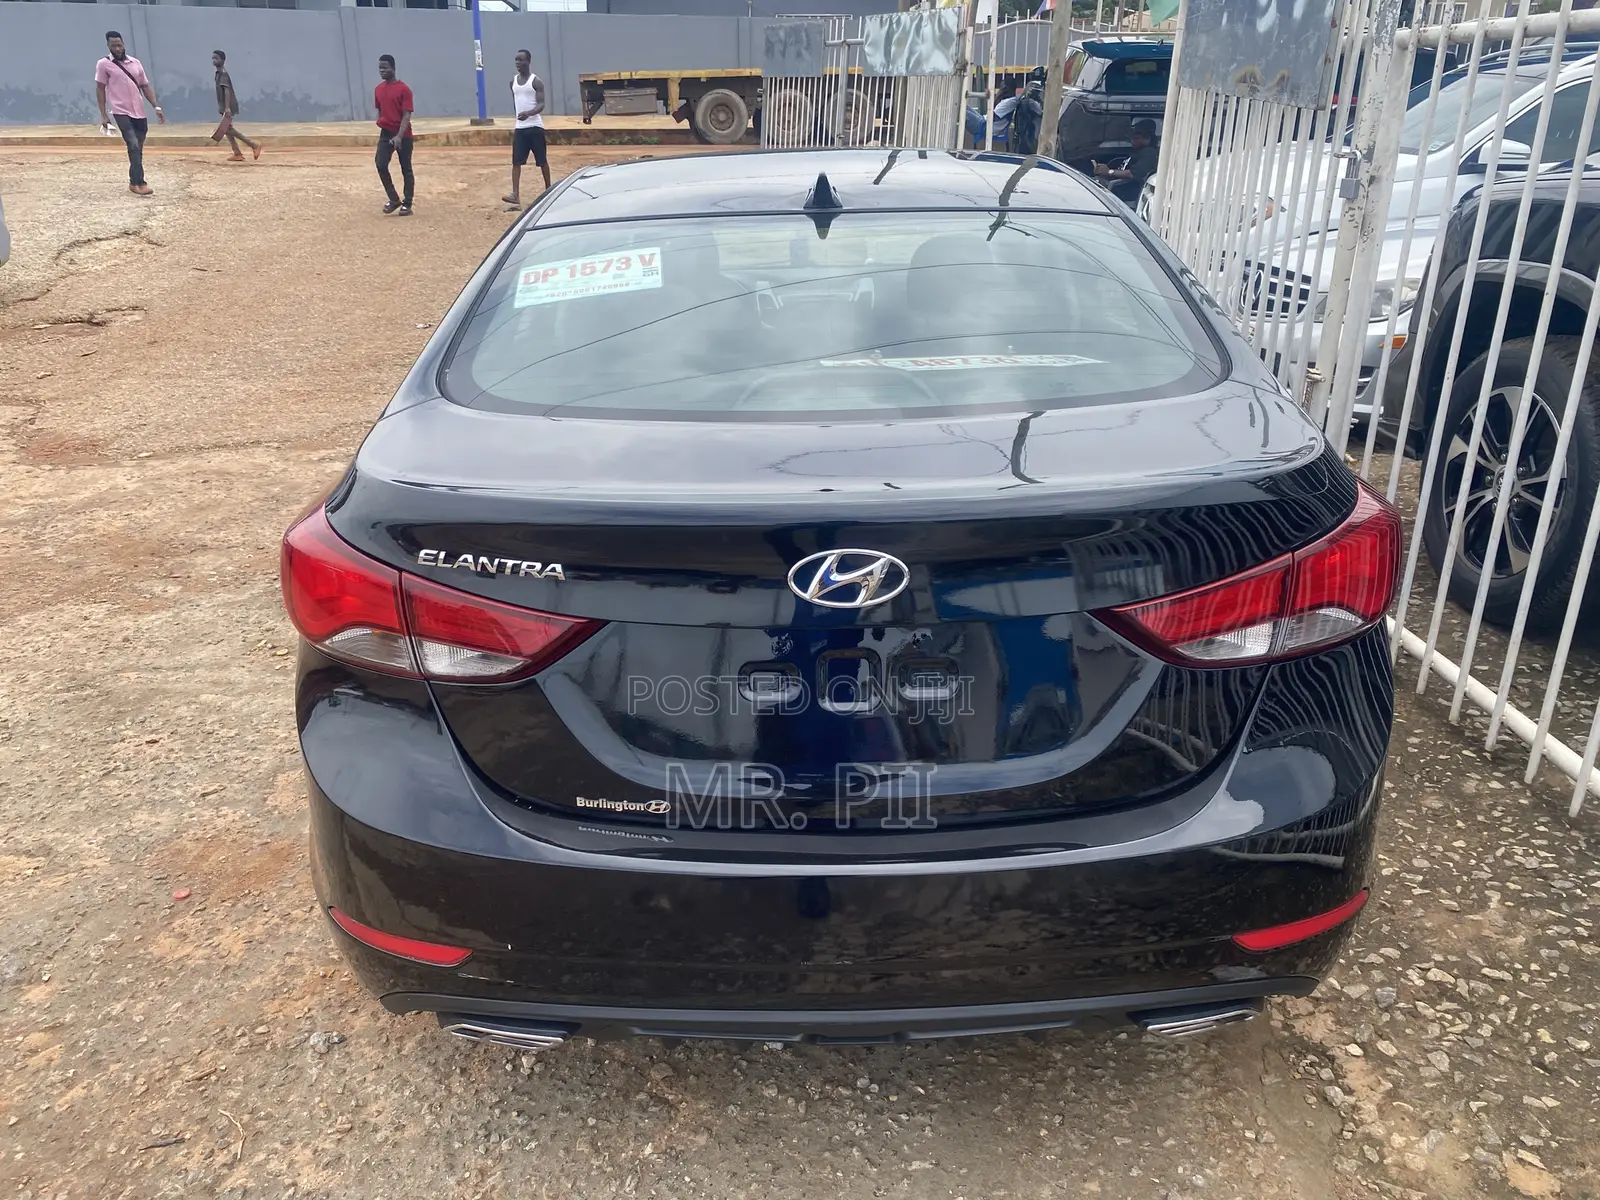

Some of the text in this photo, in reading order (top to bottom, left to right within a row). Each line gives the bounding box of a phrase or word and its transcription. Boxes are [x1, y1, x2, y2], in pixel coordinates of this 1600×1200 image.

[523, 252, 656, 286] DP 1573 V
[417, 548, 566, 581] ELANTRA
[576, 796, 645, 812] Burlington
